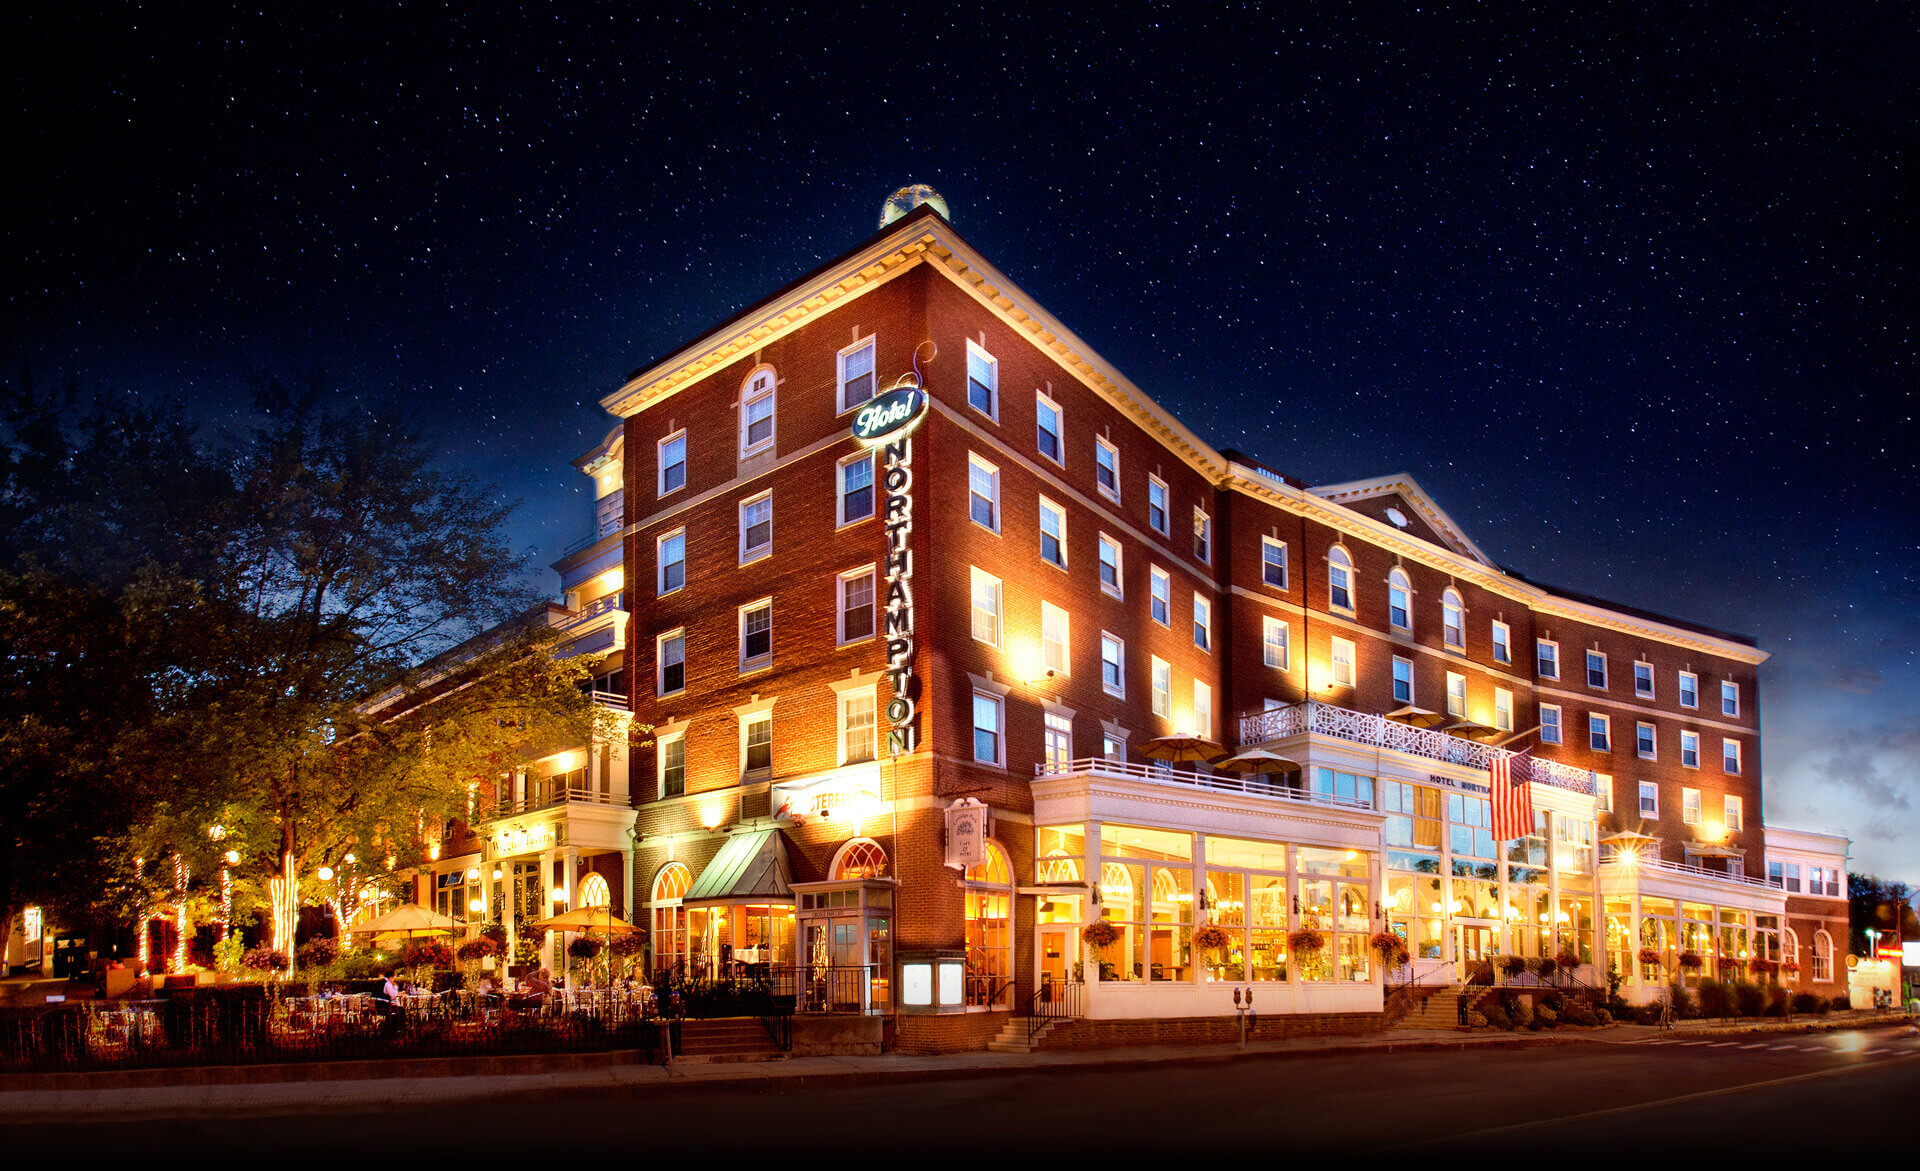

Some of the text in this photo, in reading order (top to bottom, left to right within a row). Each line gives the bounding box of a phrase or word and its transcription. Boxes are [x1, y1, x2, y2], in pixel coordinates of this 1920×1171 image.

[857, 391, 915, 437] Hotel
[884, 438, 911, 754] NORTHAMPTON
[1430, 774, 1490, 794] HOTEL NORTHA
